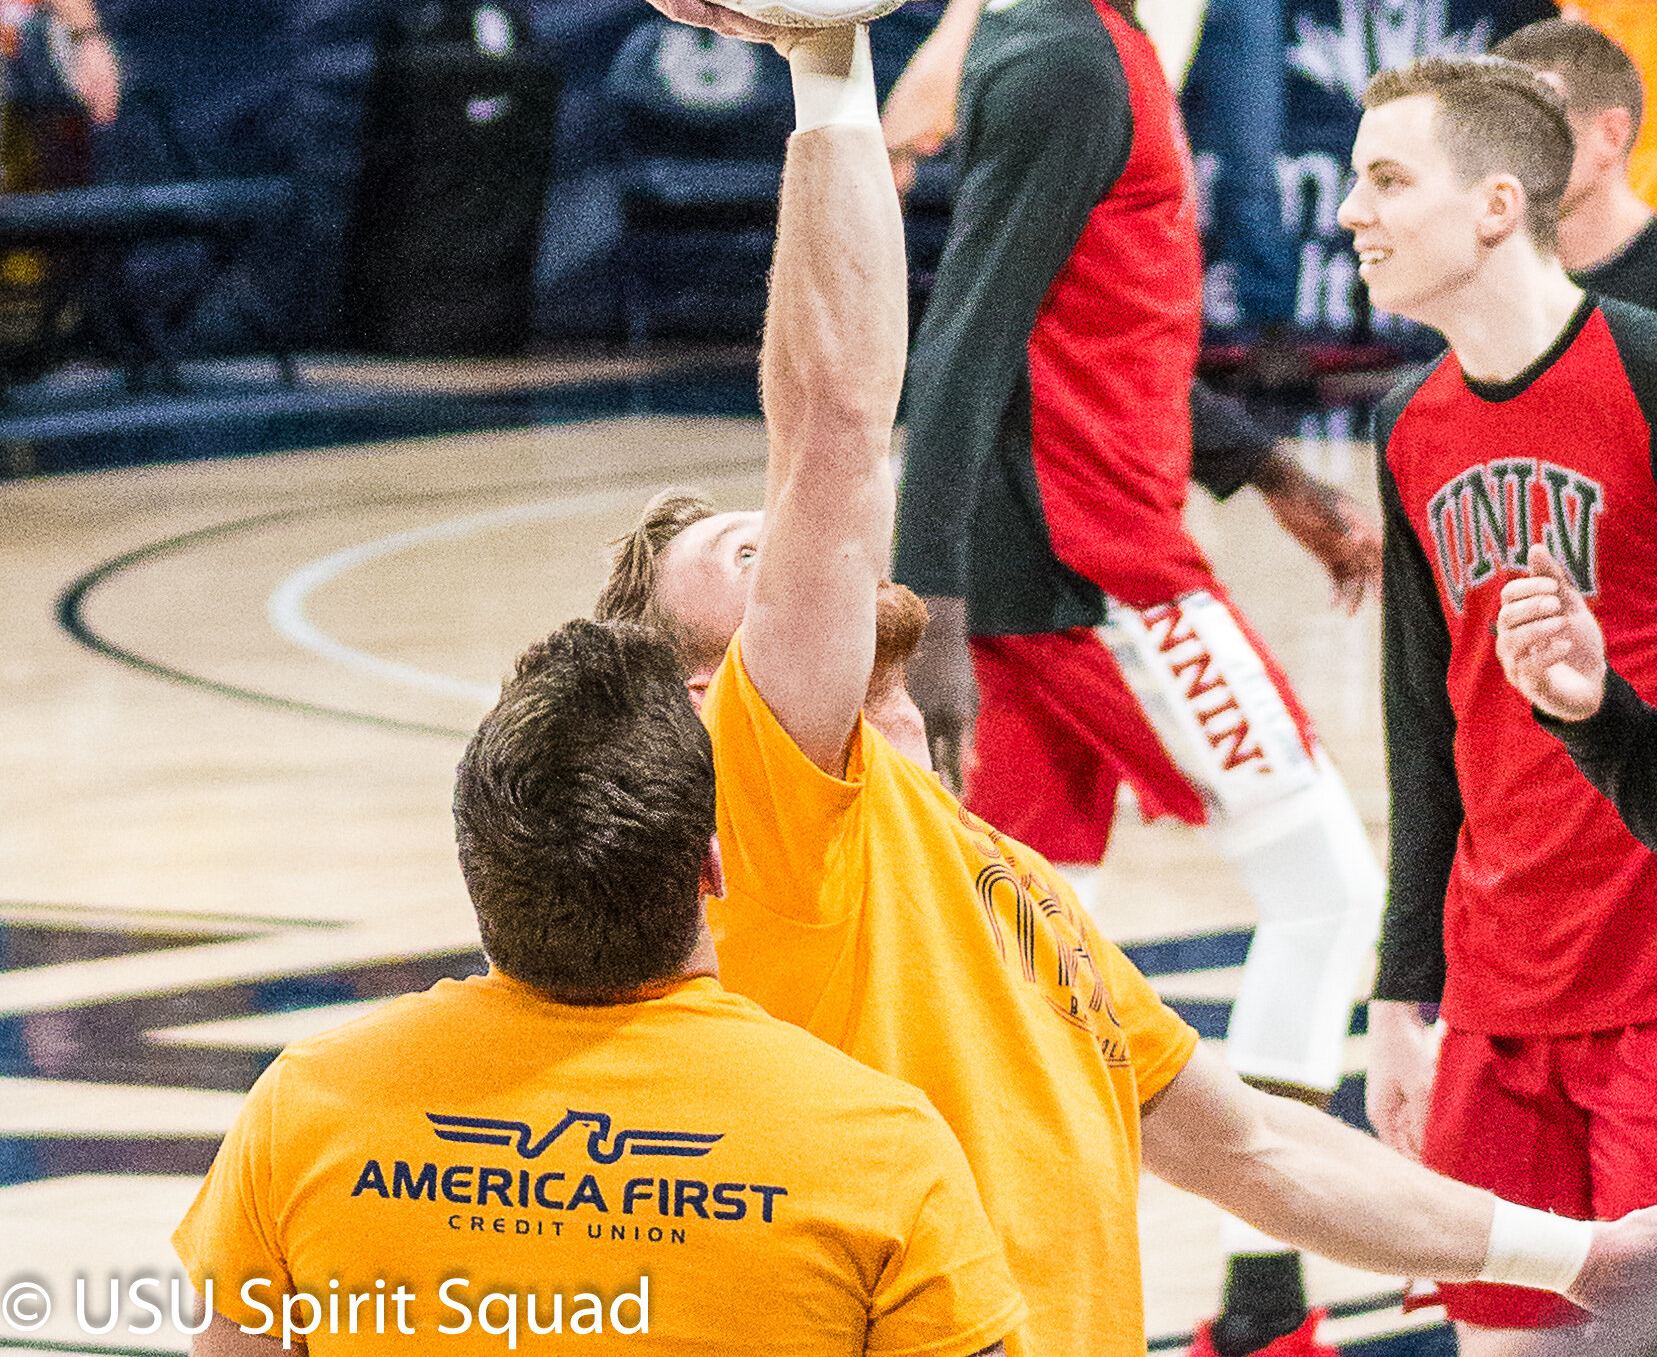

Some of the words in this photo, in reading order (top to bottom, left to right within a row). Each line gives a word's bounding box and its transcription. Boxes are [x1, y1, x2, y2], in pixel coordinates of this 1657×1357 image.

[1427, 457, 1604, 615] UNLV
[350, 1159, 609, 1214] AMERICA
[622, 1177, 789, 1225] FIRST
[447, 1214, 565, 1238] CREDIT
[587, 1224, 688, 1246] UNION
